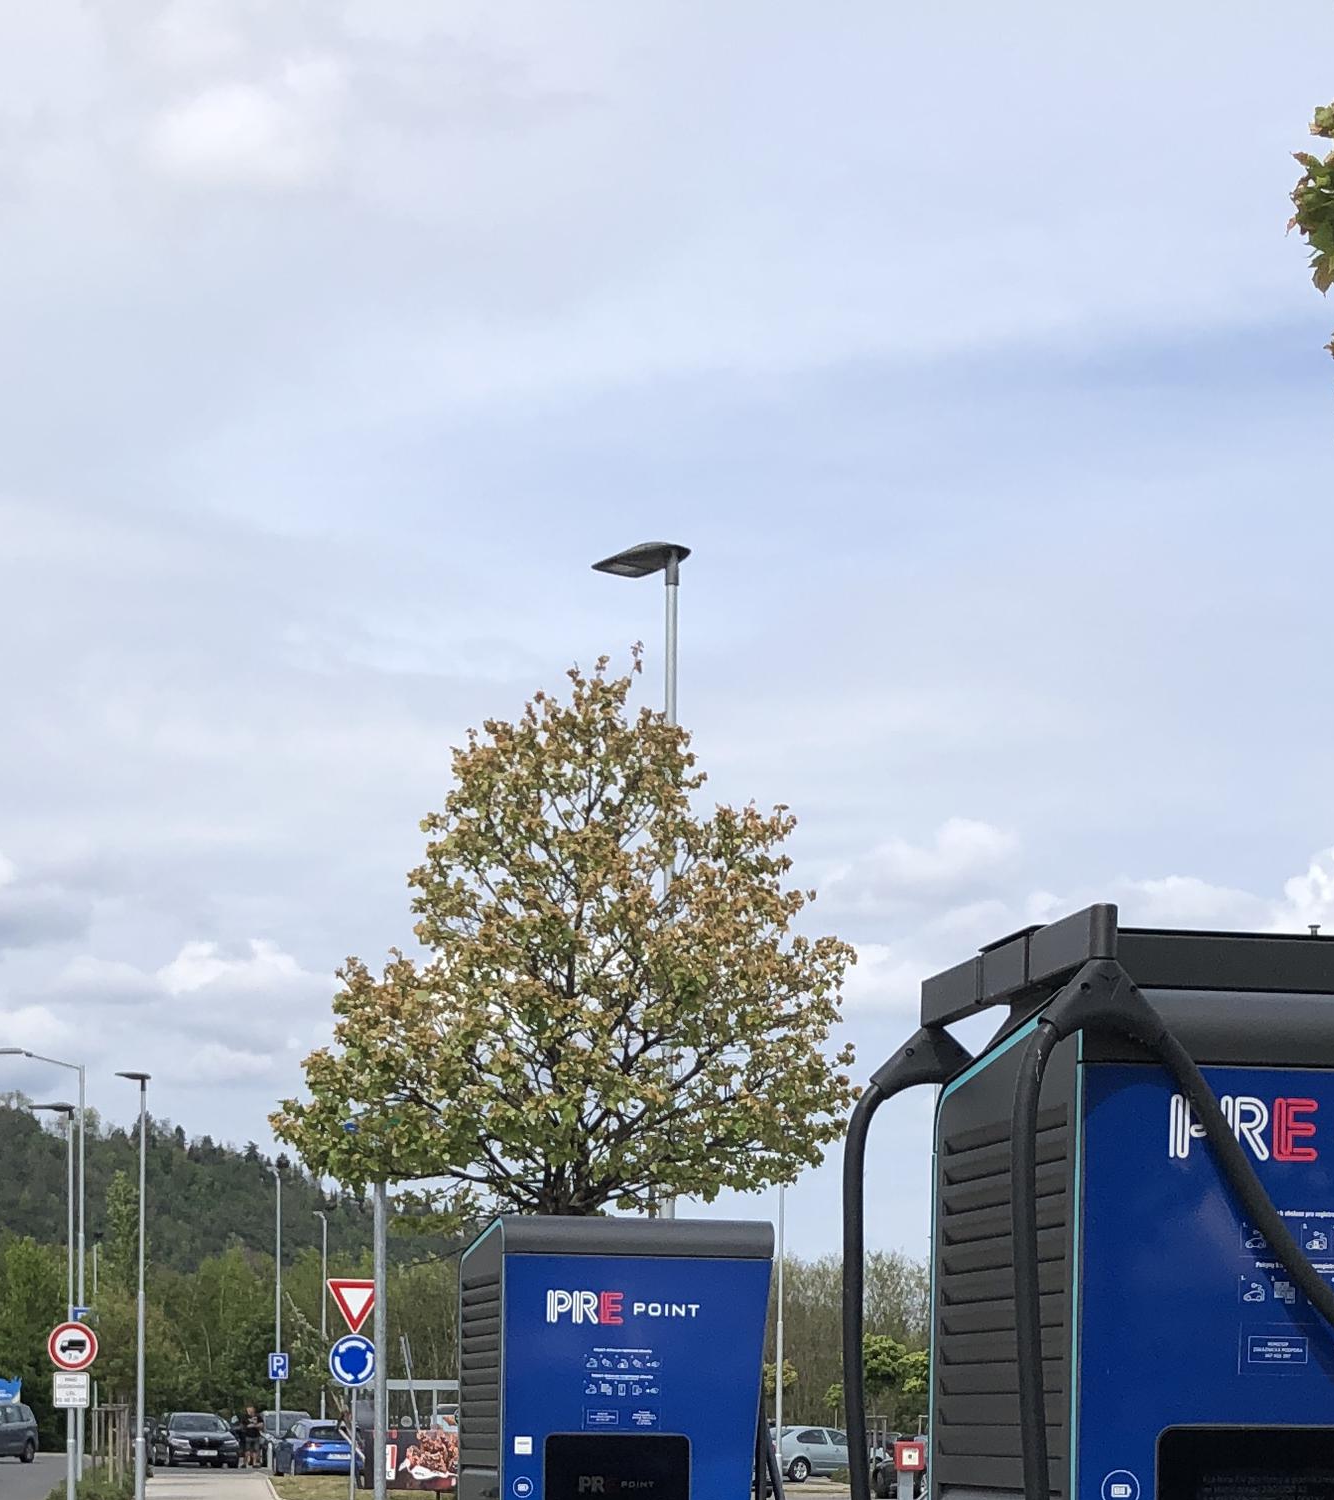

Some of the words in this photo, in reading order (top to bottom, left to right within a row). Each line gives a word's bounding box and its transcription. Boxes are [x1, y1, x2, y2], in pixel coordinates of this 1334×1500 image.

[1169, 1094, 1318, 1162] PRE
[546, 1289, 624, 1325] PRE
[633, 1302, 701, 1317] POINT
